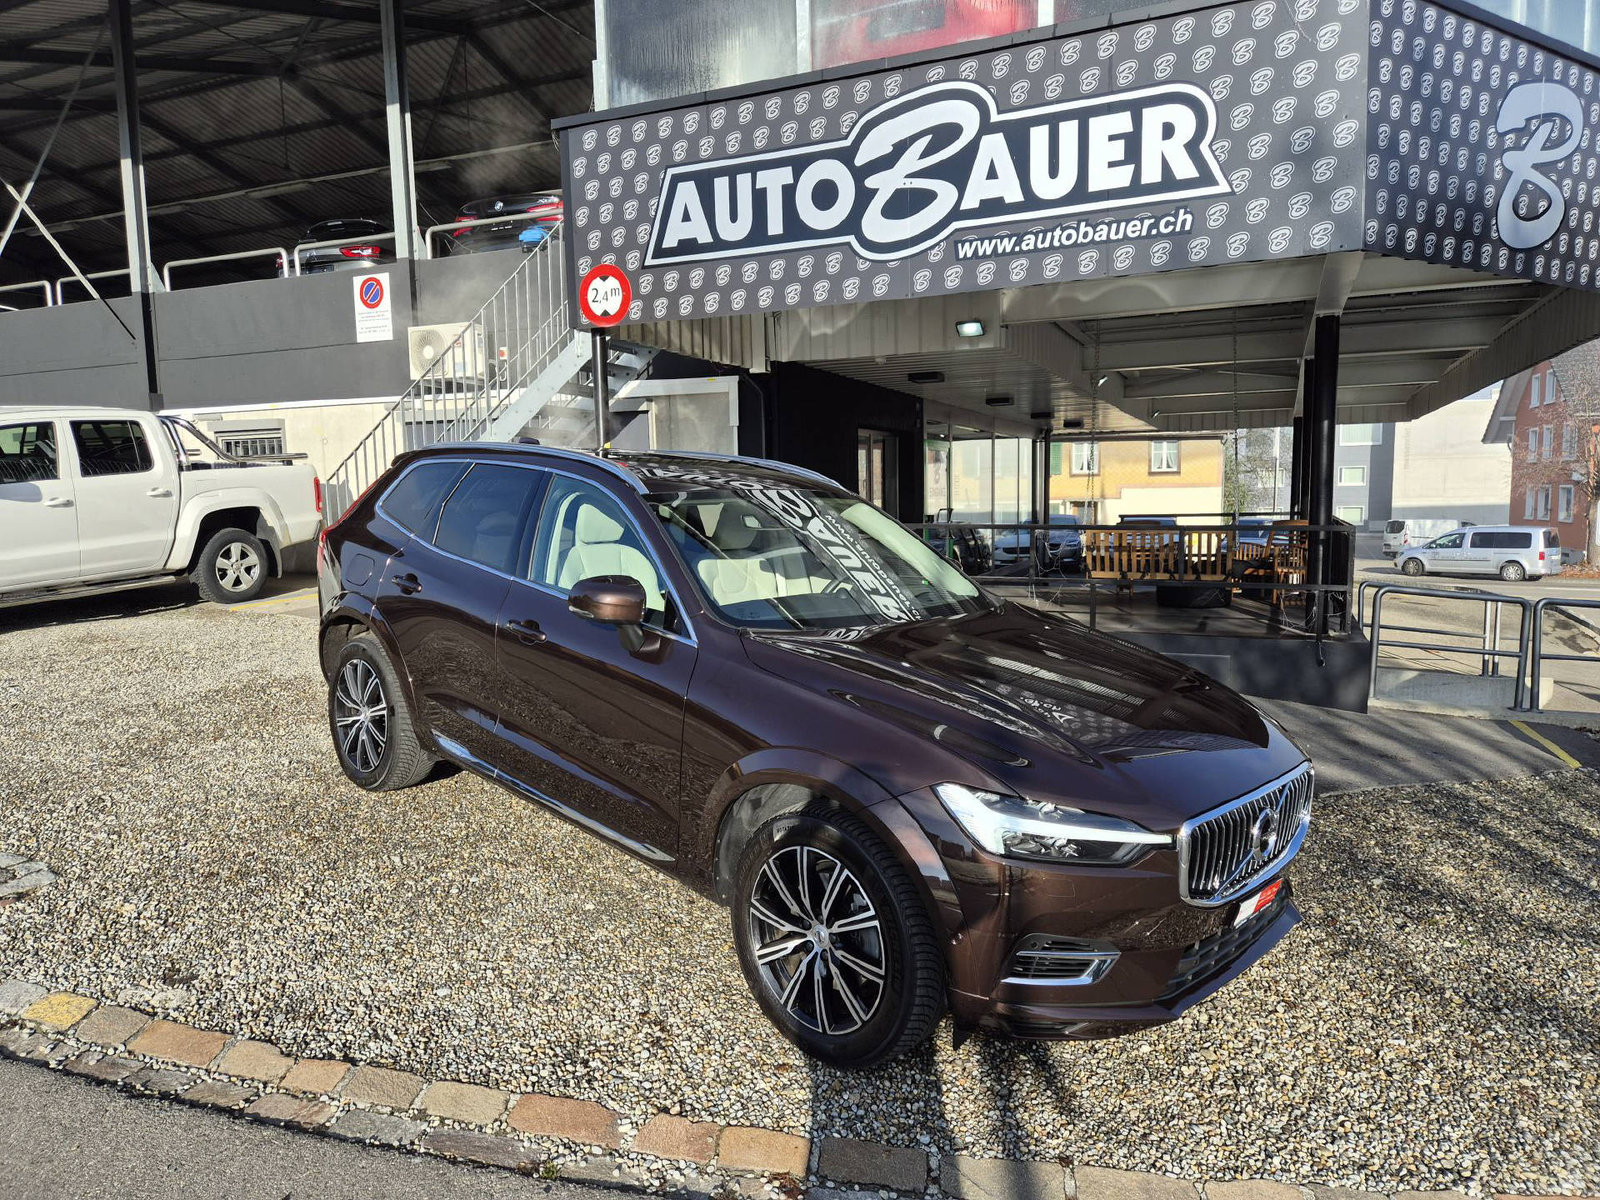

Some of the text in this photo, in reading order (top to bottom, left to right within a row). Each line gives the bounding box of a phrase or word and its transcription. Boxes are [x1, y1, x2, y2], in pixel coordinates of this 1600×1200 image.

[854, 98, 1200, 243] BAUER
[957, 208, 1193, 259] www.autobauer.ch
[1497, 82, 1584, 249] B
